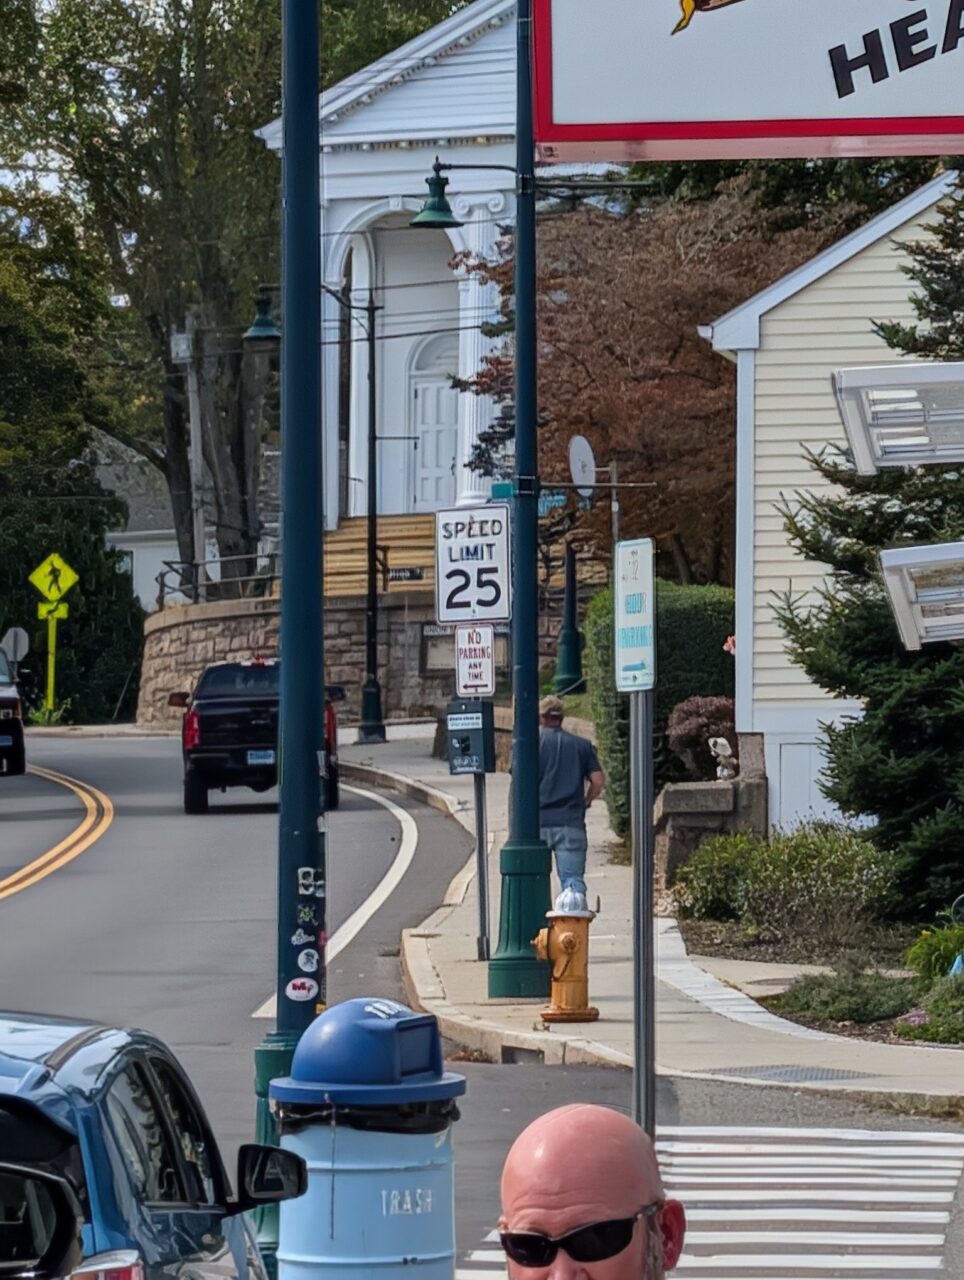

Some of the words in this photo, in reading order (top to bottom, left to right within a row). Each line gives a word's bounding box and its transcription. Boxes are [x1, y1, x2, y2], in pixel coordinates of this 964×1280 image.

[442, 519, 502, 539] SPEED
[448, 543, 496, 562] LIMIT
[445, 566, 502, 609] 25
[467, 631, 482, 644] NO
[459, 646, 491, 659] PARKING
[468, 661, 482, 670] ANY
[468, 671, 483, 681] TIME
[381, 1189, 432, 1216] TRASH
